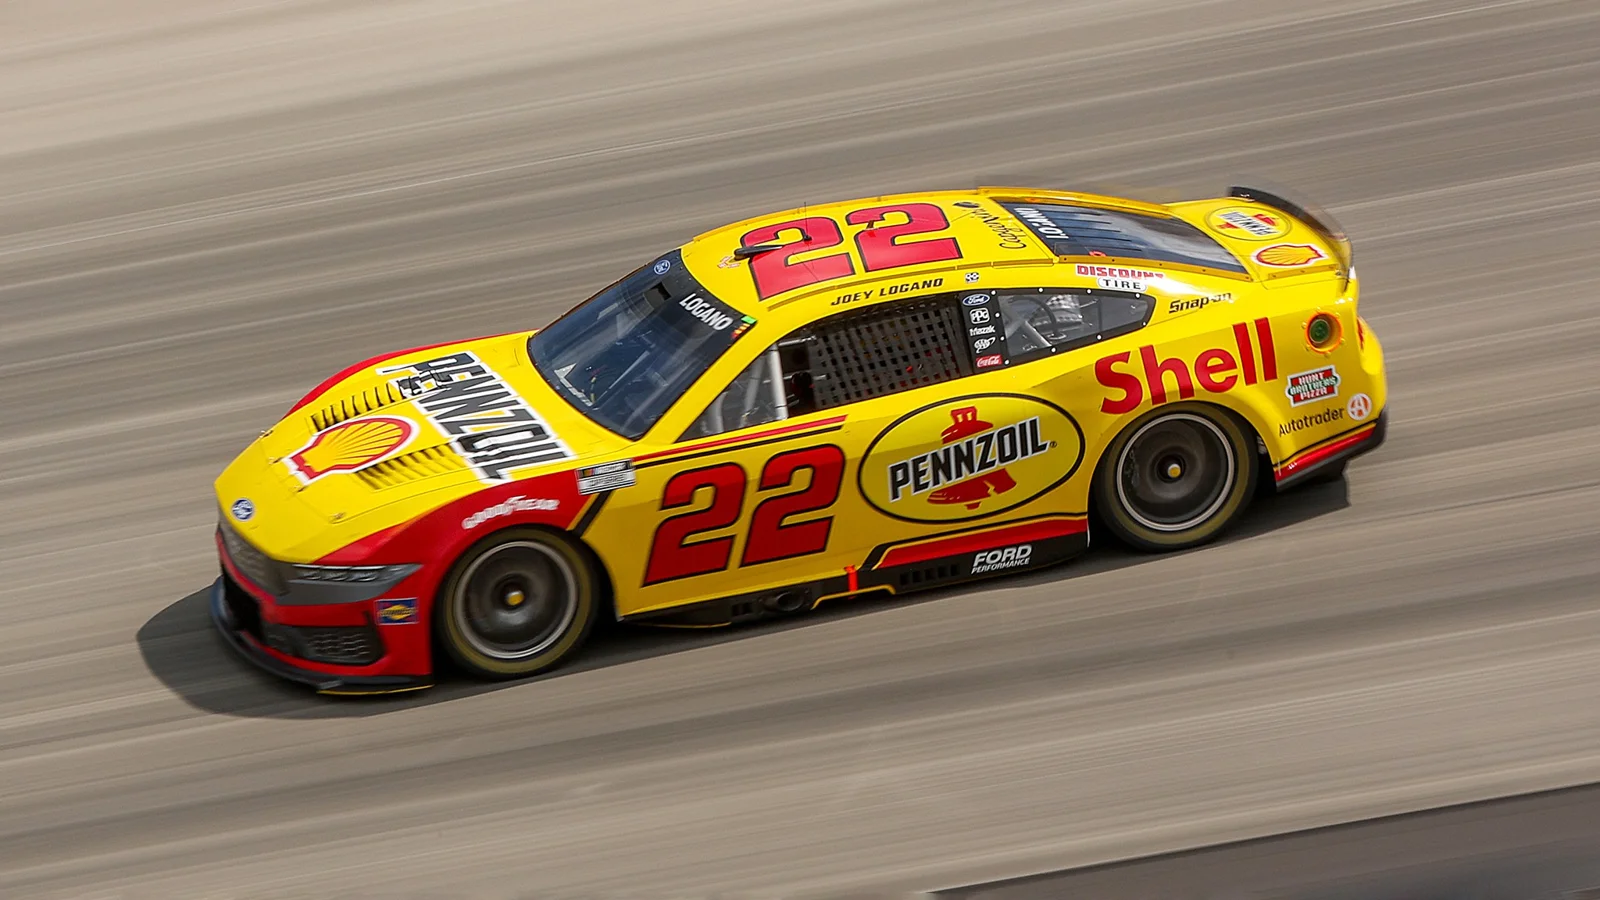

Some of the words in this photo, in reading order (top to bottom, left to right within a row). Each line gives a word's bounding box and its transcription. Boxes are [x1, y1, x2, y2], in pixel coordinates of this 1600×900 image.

[739, 203, 963, 302] 22
[830, 290, 873, 306] JOEY
[879, 278, 944, 297] LOGANO
[1103, 279, 1142, 290] TIRE
[679, 293, 734, 330] LOGANO
[1094, 317, 1278, 415] Shell
[1298, 371, 1326, 385] HUNT
[1300, 387, 1328, 400] PIZZA
[381, 351, 573, 480] PENNZOIL
[1279, 408, 1345, 438] Autotrader
[888, 416, 1049, 503] PENNZOIL
[641, 443, 846, 589] 22
[971, 557, 1031, 575] PERFORMANCE
[972, 544, 1032, 567] FORD
